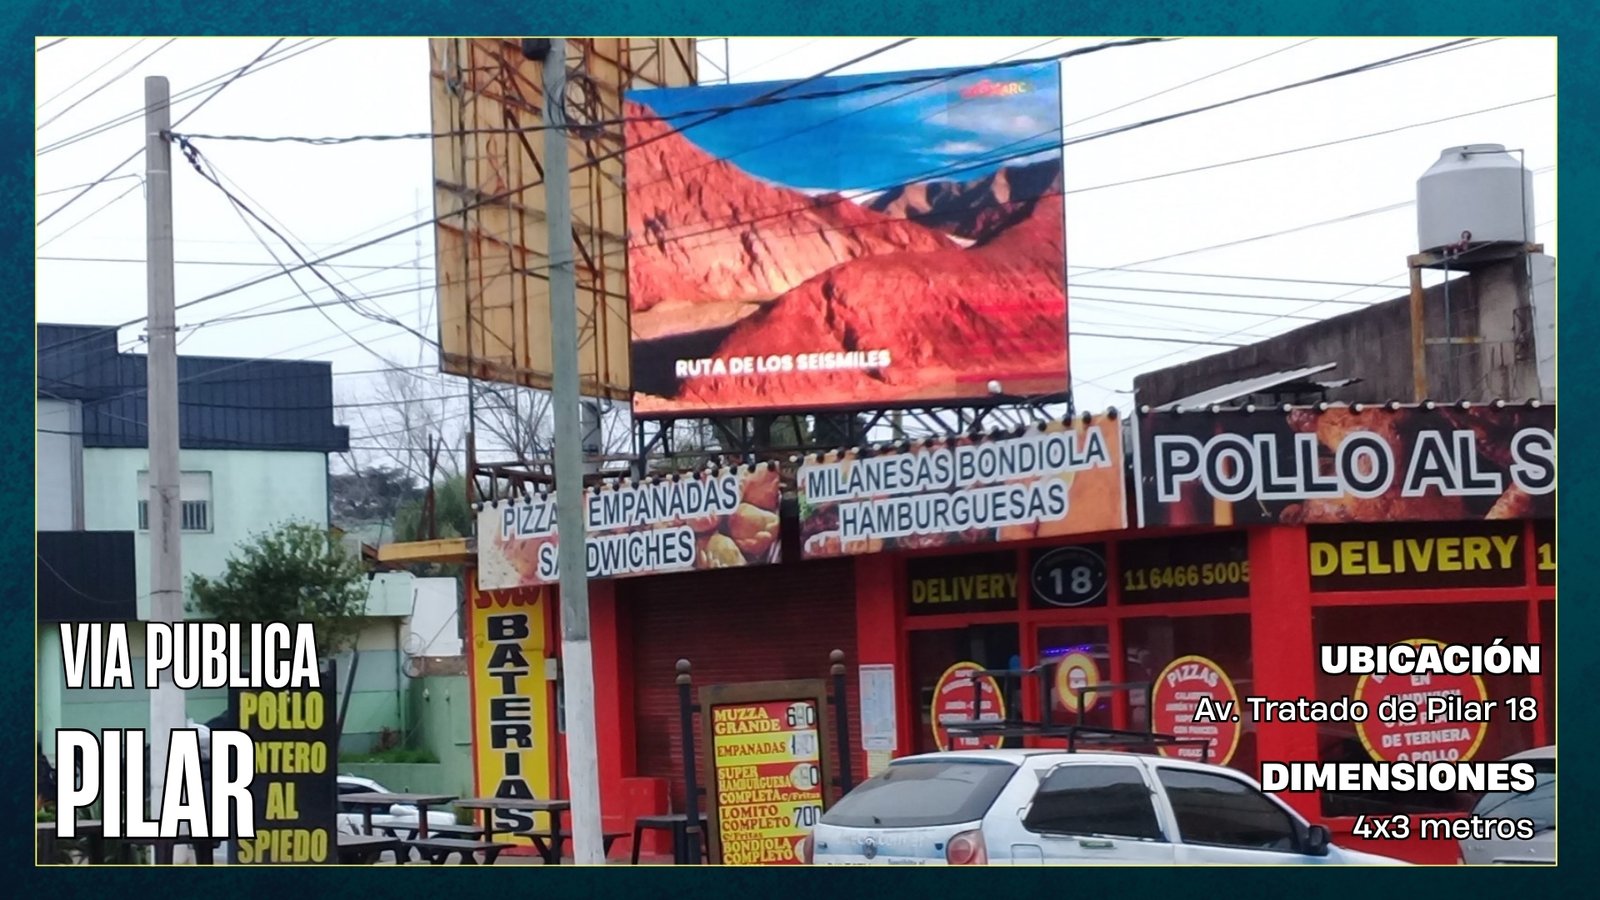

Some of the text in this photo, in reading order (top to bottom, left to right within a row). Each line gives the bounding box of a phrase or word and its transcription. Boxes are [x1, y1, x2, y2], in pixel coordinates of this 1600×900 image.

[676, 349, 891, 377] RUTA DE LOS SEISMILES
[808, 431, 1106, 498] MILANESAS BONDIOLA
[1155, 428, 1556, 502] POLLO AL S
[503, 476, 738, 537] PIZZA EMPANADAS
[842, 484, 1065, 536] HAMBURGUESAS
[540, 530, 693, 576] SDWICHES
[1310, 535, 1519, 576] DELIVERY
[912, 573, 1018, 604] DELIVERY
[1049, 566, 1093, 595] 18
[1124, 560, 1250, 591] 11 6466 5005
[1167, 663, 1220, 688] PIZZAS
[239, 690, 324, 731] POLLO
[487, 613, 534, 833] BATERIAS
[713, 707, 769, 723] MUZZA
[715, 718, 781, 735] GRANDE
[1382, 728, 1471, 749] DE TERNERA
[255, 741, 327, 774] NTERO
[717, 741, 786, 758] EMPANADAS
[1411, 748, 1459, 762] POLLO
[719, 766, 759, 780] SUPER
[265, 782, 299, 820] AL
[720, 788, 782, 805] COMPLETA
[721, 804, 778, 820] LOMITO
[722, 816, 791, 832] COMPLETO
[238, 829, 328, 864] SPIEDO
[724, 838, 792, 853] BONDIOLA
[724, 849, 793, 865] COMPLETO
